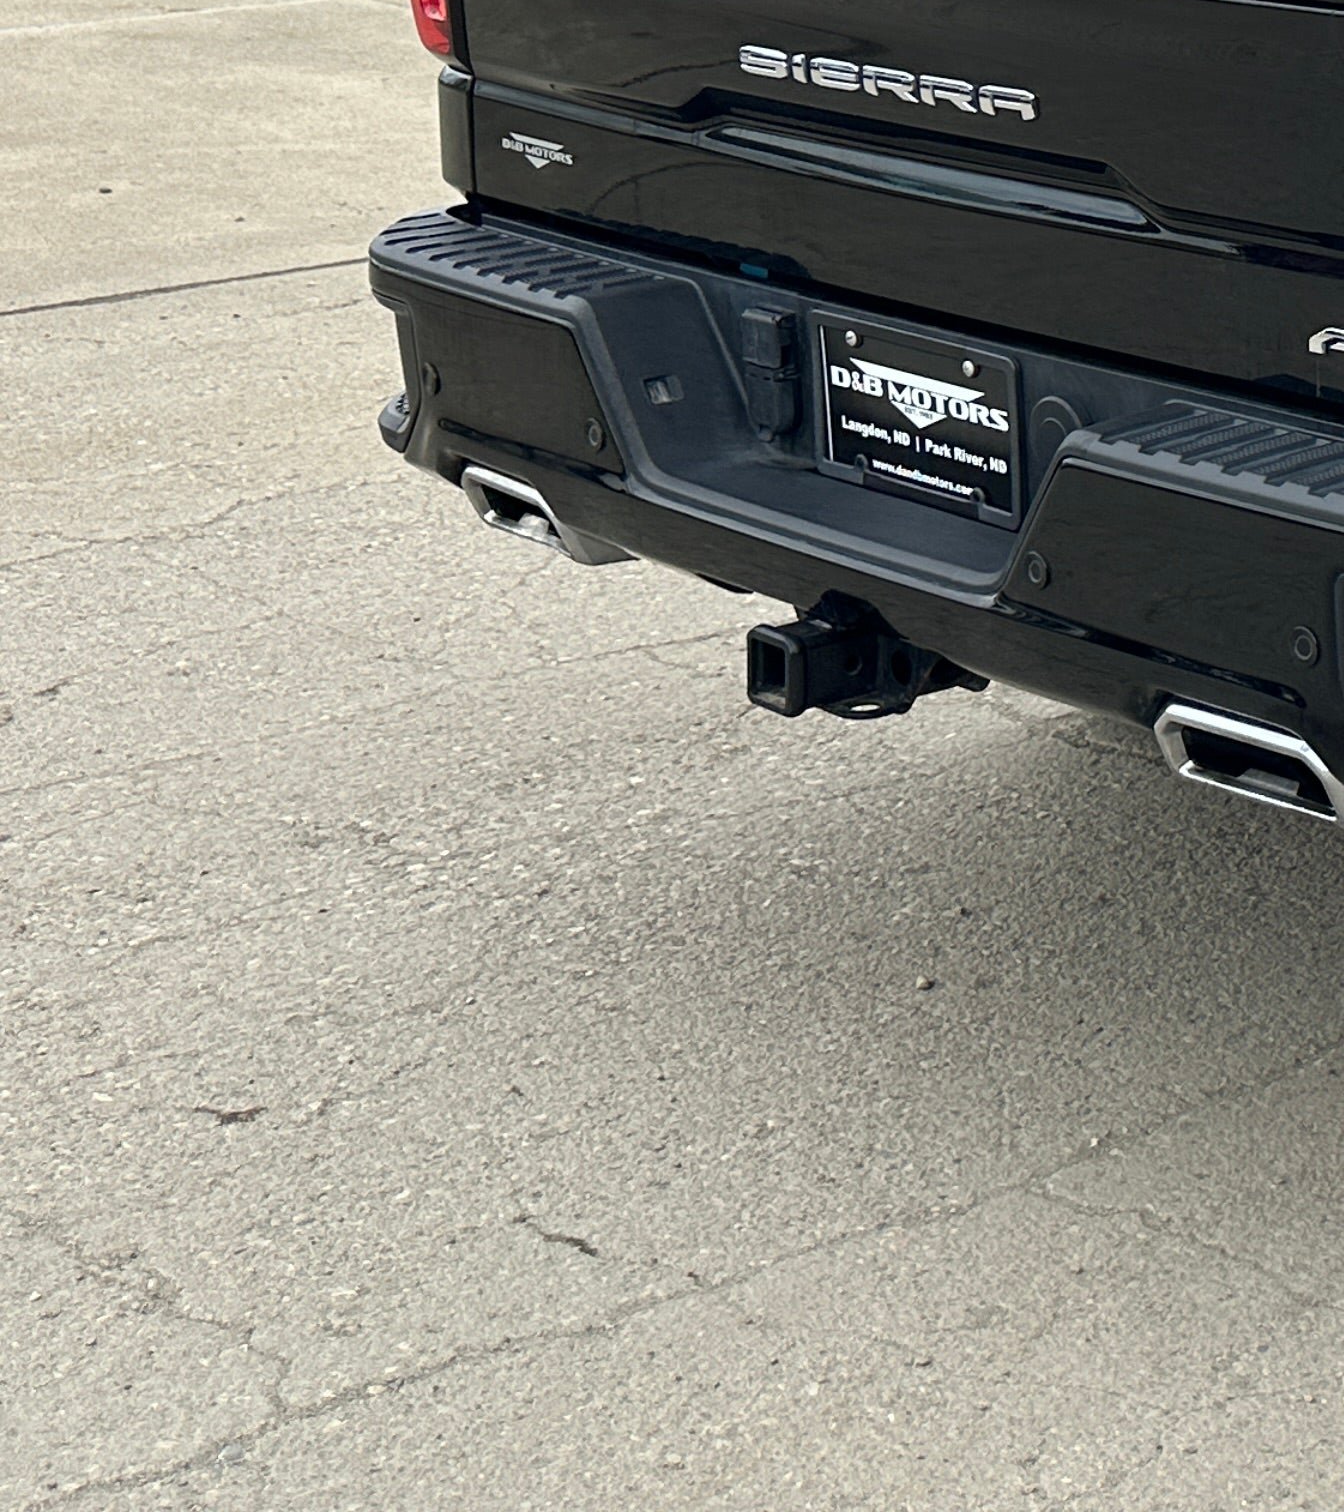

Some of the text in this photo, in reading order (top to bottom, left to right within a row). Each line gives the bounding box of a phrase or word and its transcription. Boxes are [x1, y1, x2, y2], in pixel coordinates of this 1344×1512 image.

[737, 44, 1039, 122] SIERRA
[525, 144, 574, 166] MOTORS
[830, 365, 1010, 433] D&B MOTORS
[841, 415, 892, 444] Langdon,
[893, 430, 911, 447] ND
[925, 438, 952, 459] Park
[953, 447, 987, 471] River,
[989, 457, 1008, 474] ND
